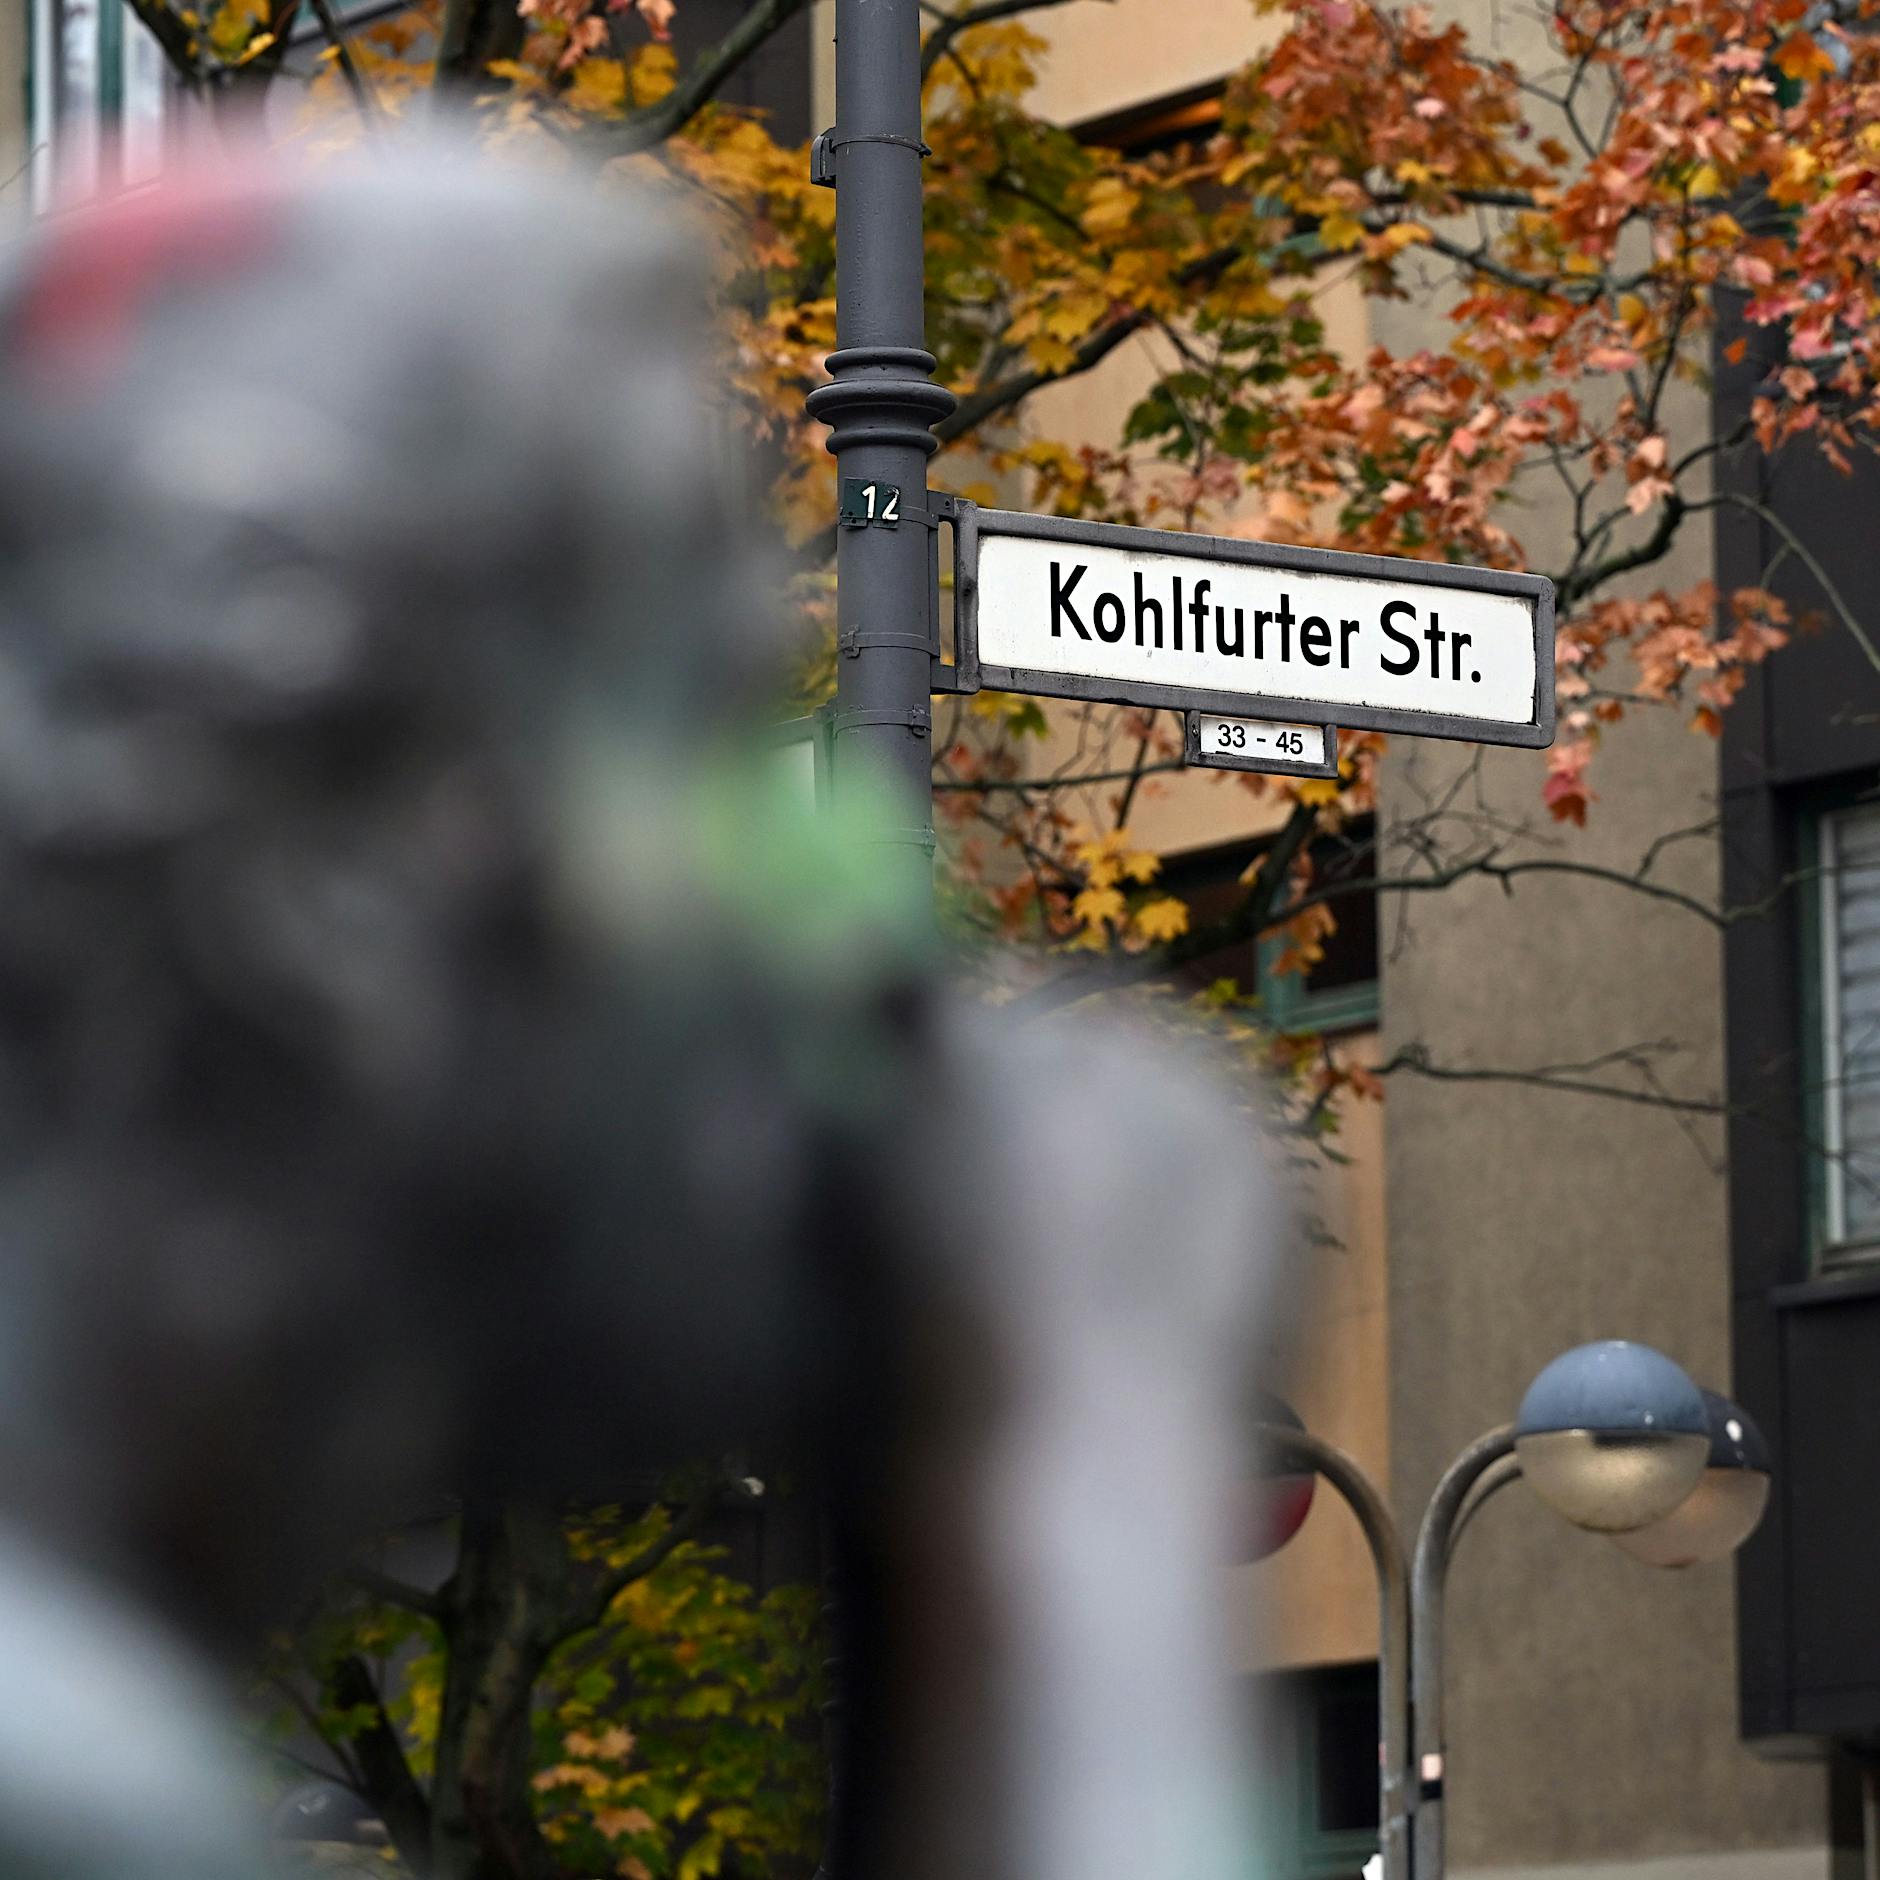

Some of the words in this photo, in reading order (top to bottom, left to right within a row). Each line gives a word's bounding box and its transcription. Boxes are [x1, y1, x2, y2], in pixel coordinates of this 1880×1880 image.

[861, 485, 900, 521] 12
[1049, 561, 1360, 669] Kohlfurter
[1379, 600, 1483, 683] Str.
[1217, 723, 1246, 749] 33
[1275, 731, 1304, 755] 45
